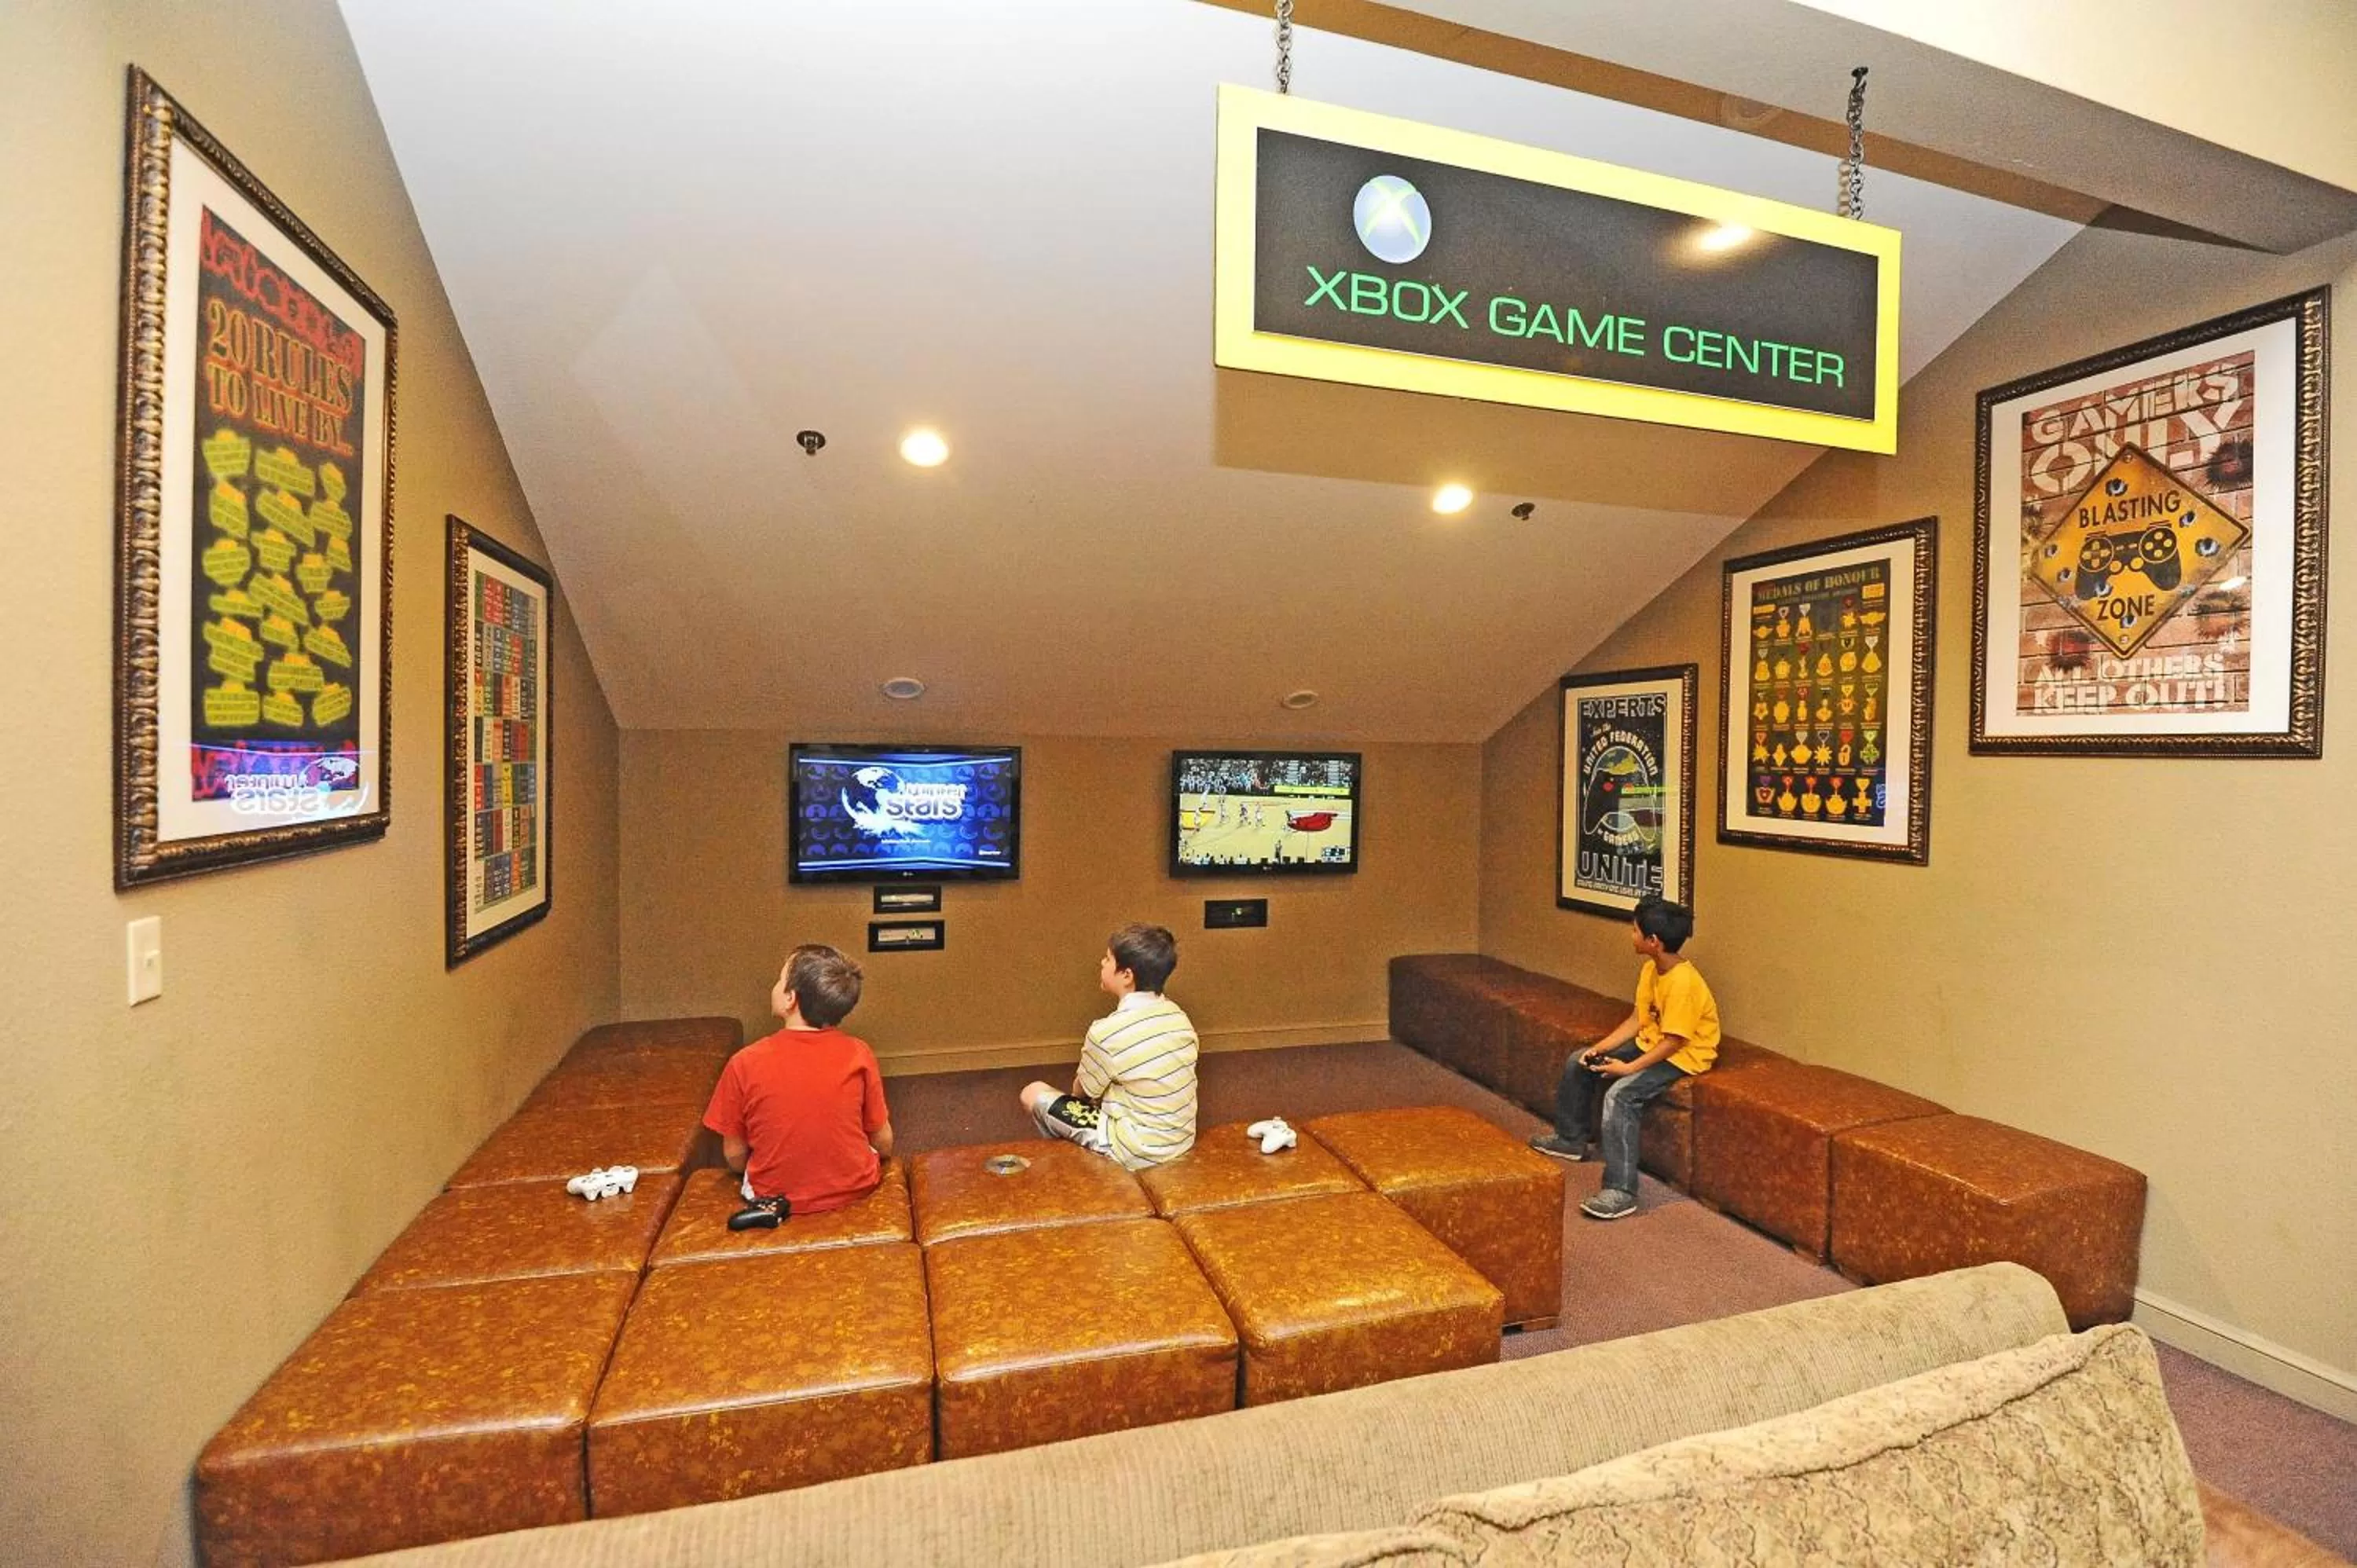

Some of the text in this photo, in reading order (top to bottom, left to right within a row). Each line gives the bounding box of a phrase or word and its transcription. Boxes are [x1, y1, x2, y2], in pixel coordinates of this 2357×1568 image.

[1305, 266, 1844, 387] XBOX GAME CENTER
[209, 298, 354, 414] 20 RULES
[207, 361, 247, 417] TO
[252, 380, 309, 441] LIVE
[2031, 364, 2239, 445] GAMERS
[2079, 491, 2181, 529] BLASTING
[2096, 594, 2155, 621] ZONE
[2101, 653, 2225, 681] OTHERS
[1580, 694, 1666, 719] EXPERTS
[2034, 683, 2118, 715] KEEP
[1578, 849, 1663, 892] UNITE
